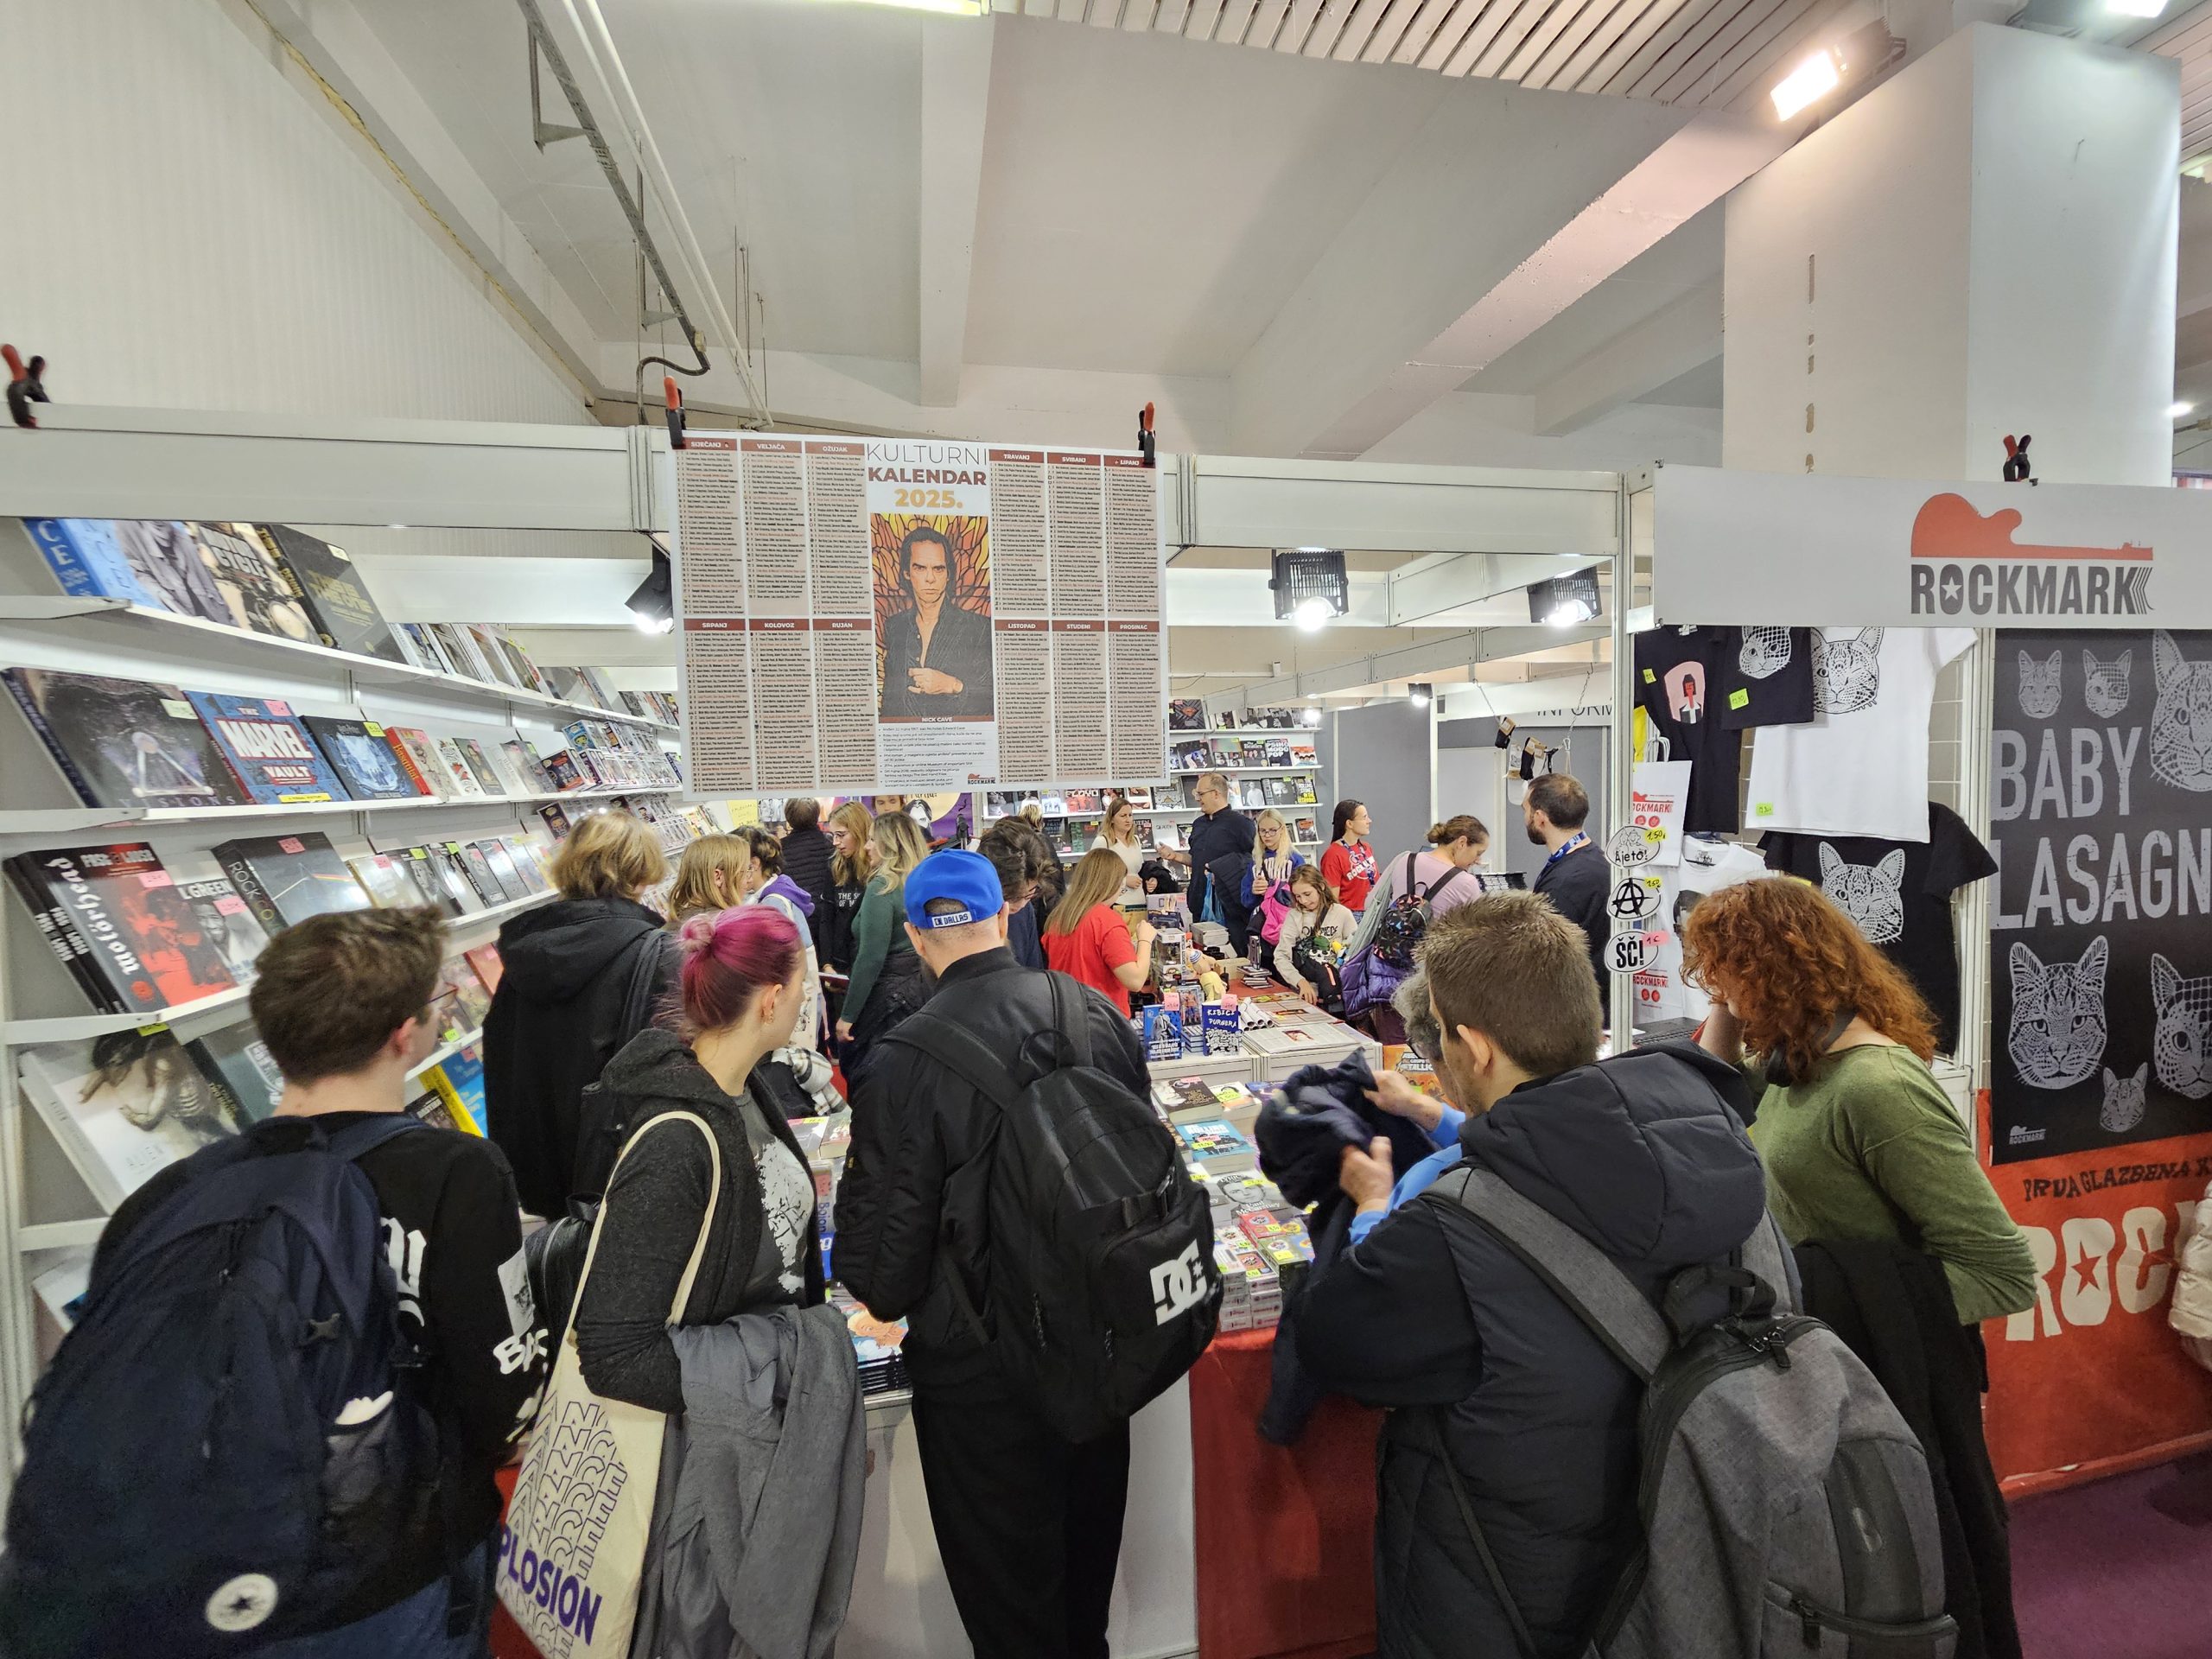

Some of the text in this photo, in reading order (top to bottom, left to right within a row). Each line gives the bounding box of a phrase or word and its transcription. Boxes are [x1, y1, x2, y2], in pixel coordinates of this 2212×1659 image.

[867, 443, 987, 466] KULTURNI
[868, 467, 987, 486] KALENDAR
[894, 488, 963, 509] 2025.
[1910, 563, 2153, 615] ROCKMARK
[217, 720, 314, 759] MARVEL
[263, 766, 310, 778] VAULT
[1991, 727, 2143, 821] BABY
[1065, 789, 1099, 798] FLOYD
[1632, 803, 1673, 813] CKMARK
[188, 880, 234, 898] GREEN
[228, 861, 261, 899] ROCK
[1991, 828, 2212, 930] LASAGN
[944, 913, 969, 925] DALLAS
[1616, 936, 1644, 969] ŠČ!
[2023, 1176, 2081, 1201] PRVA
[2080, 1160, 2188, 1193] GLAZBENA
[2005, 1200, 2196, 1341] ROC
